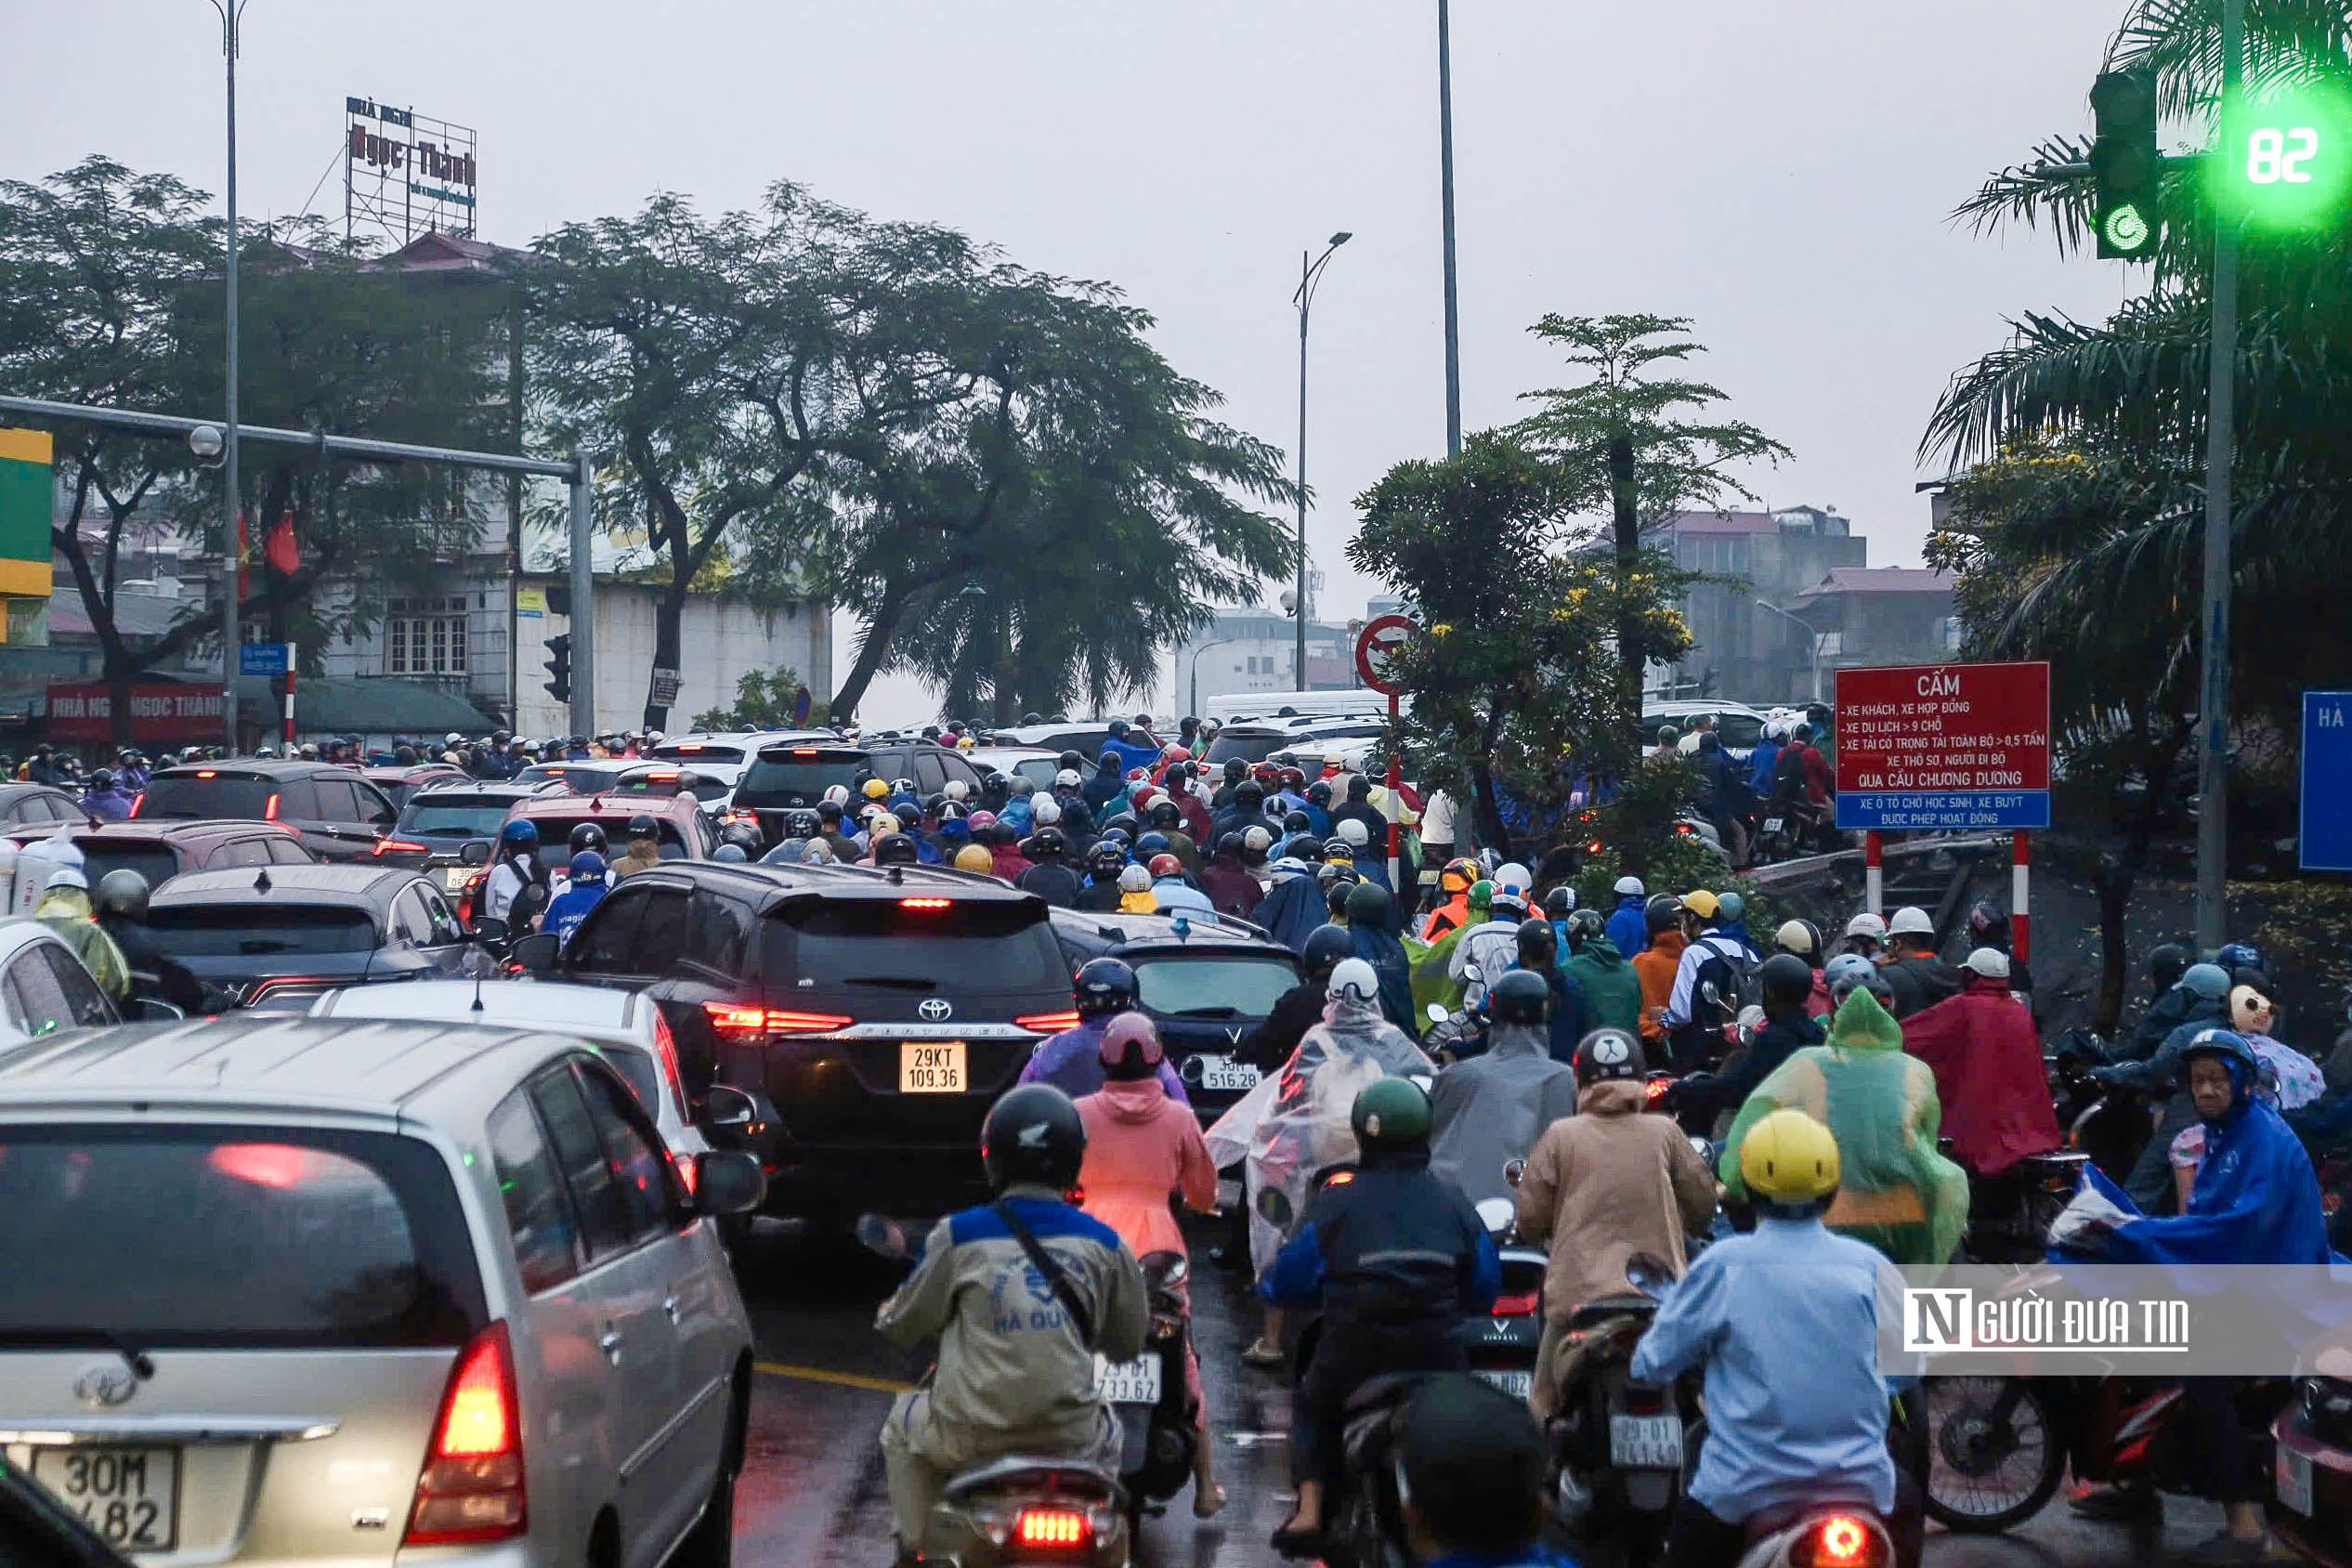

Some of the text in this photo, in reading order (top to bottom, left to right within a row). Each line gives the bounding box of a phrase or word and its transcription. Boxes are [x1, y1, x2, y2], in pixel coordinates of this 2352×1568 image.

[2247, 128, 2318, 184] 82
[1917, 667, 1960, 696] CẤM
[1901, 703, 1914, 714] XE
[2319, 701, 2345, 727] HÀ
[1862, 722, 1875, 733] DU
[1912, 720, 1918, 732] 9
[2023, 729, 2045, 746] TẤN
[1887, 755, 1900, 766] XE
[1859, 773, 1884, 788] QUA
[1888, 768, 1914, 787] CẦU
[1918, 770, 1970, 787] CHƯƠNG
[1860, 798, 1874, 810] XE
[1978, 797, 1992, 808] XE
[915, 1049, 952, 1067] 29KT
[908, 1069, 958, 1088] 109.36
[1209, 1073, 1257, 1088] 516.28
[65, 1455, 147, 1496] 30M
